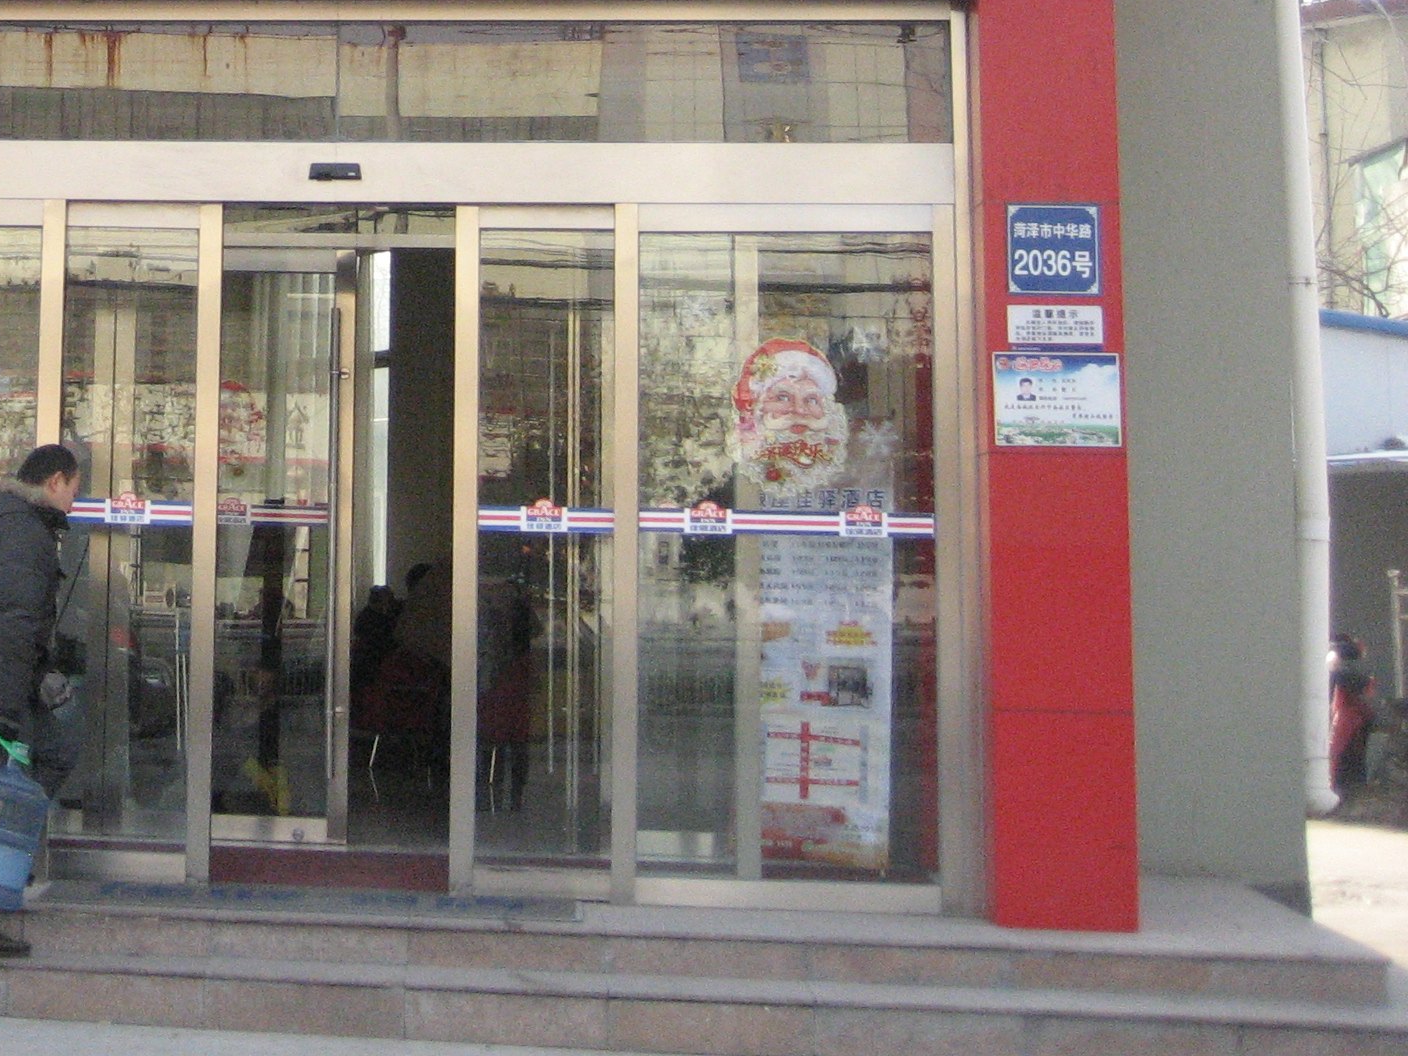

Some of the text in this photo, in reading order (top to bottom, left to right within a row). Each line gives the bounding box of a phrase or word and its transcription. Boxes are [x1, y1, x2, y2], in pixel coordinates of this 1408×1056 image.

[1013, 222, 1092, 239] 菏泽市中华路
[1013, 249, 1093, 278] 2036号
[1032, 309, 1079, 319] 温馨提示
[528, 505, 560, 516] GRACE
